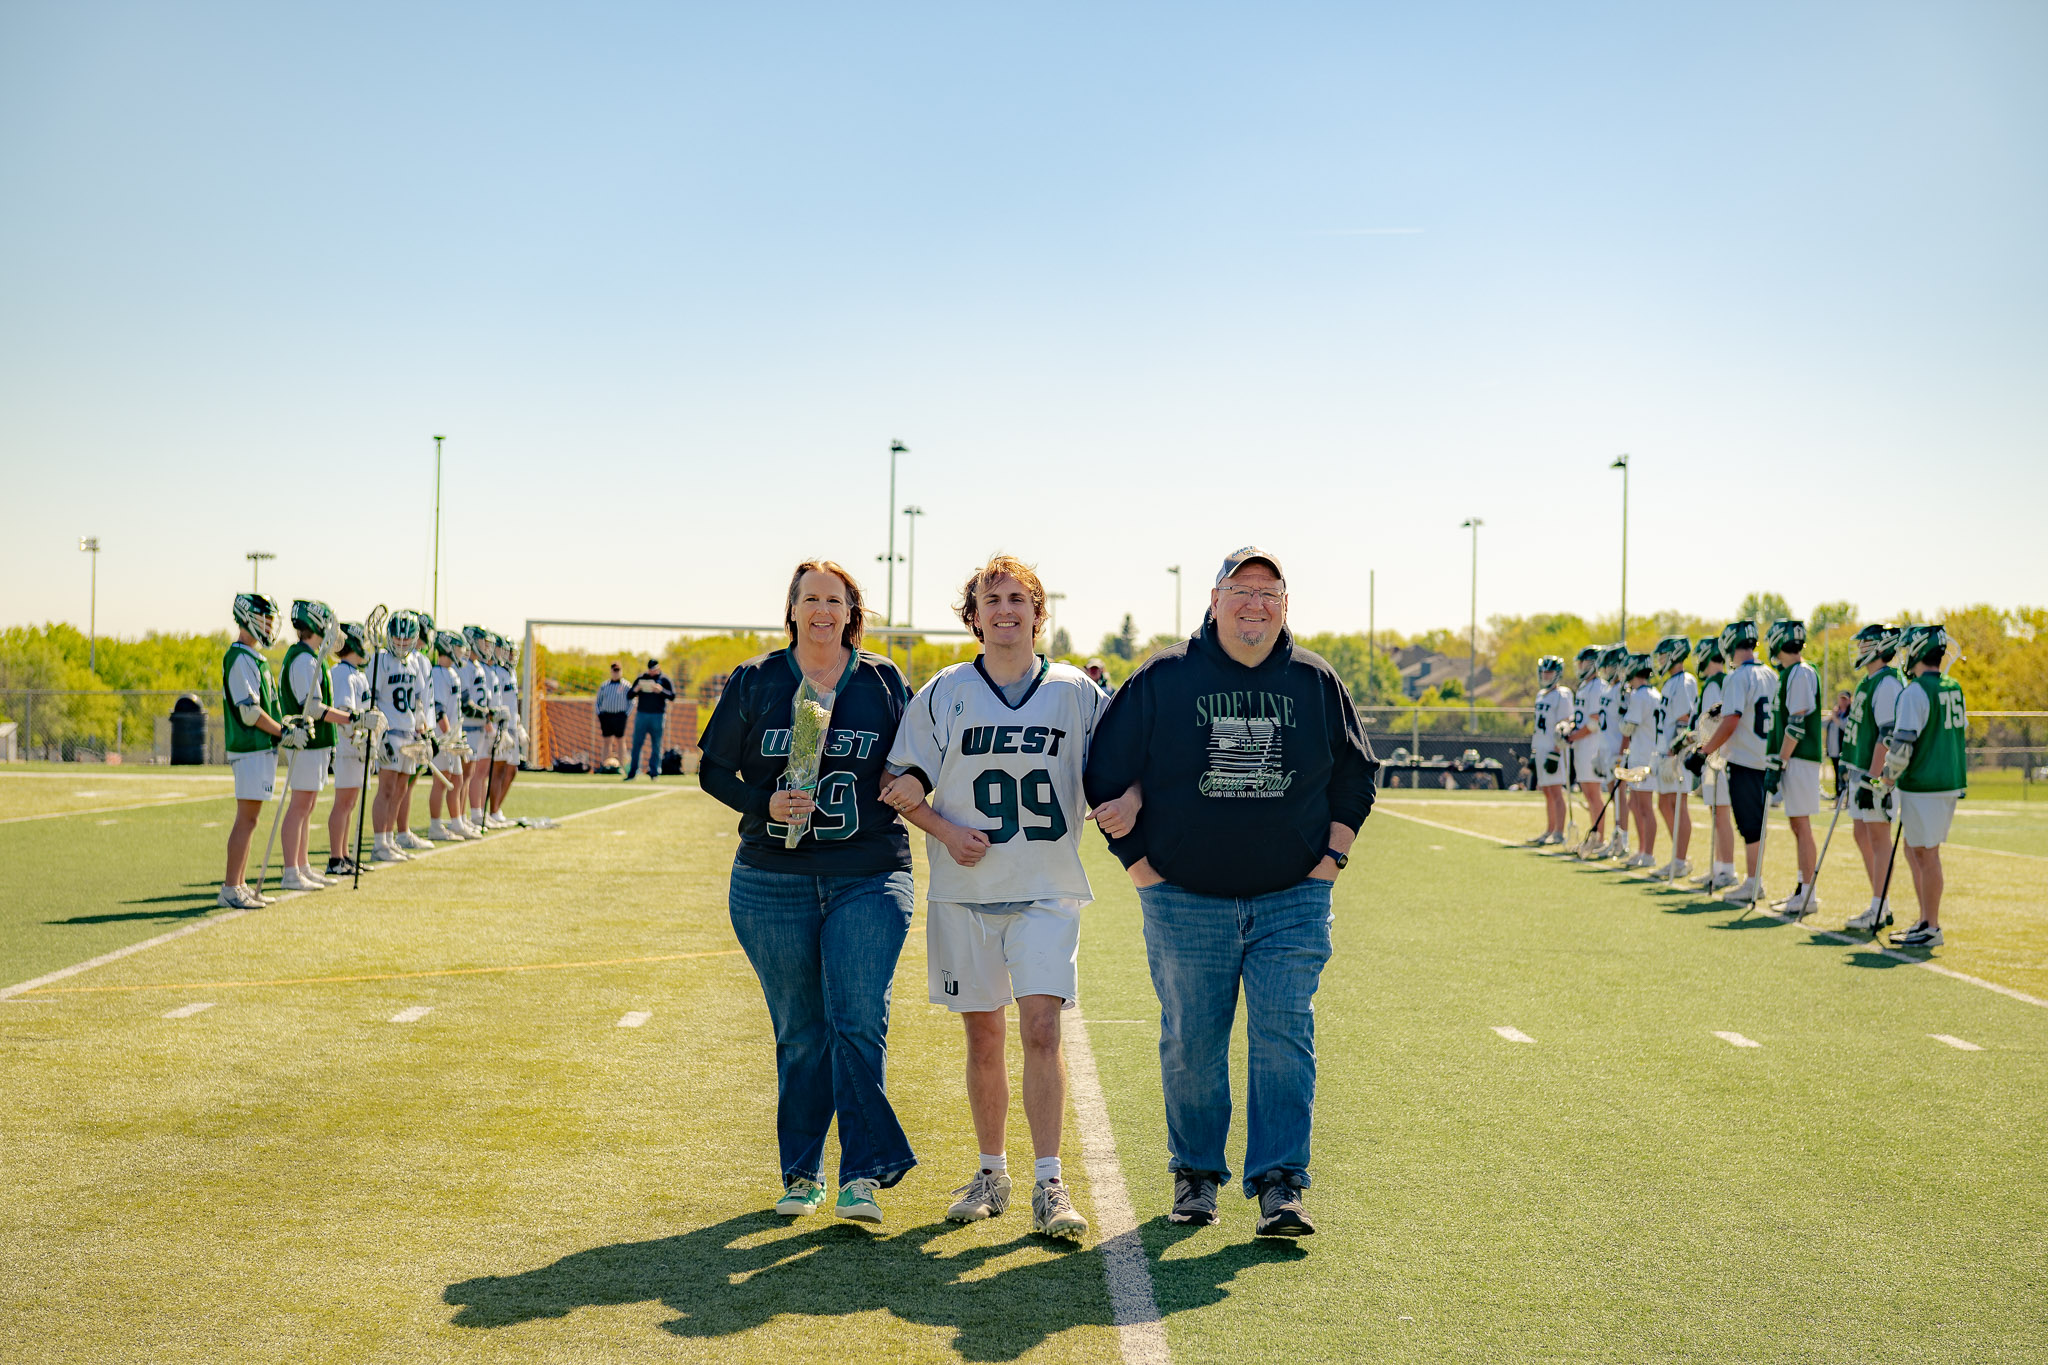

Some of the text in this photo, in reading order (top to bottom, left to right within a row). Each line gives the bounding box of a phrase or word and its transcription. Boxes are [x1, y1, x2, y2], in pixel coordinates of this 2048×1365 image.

[1196, 691, 1296, 728] SIDELINE
[1938, 690, 1964, 729] 75
[760, 729, 880, 759] WST
[961, 725, 1067, 757] WEST
[1199, 769, 1296, 795] Social Club
[1236, 790, 1246, 798] AND
[1260, 790, 1284, 798] DECISIONS
[973, 768, 1068, 845] 99
